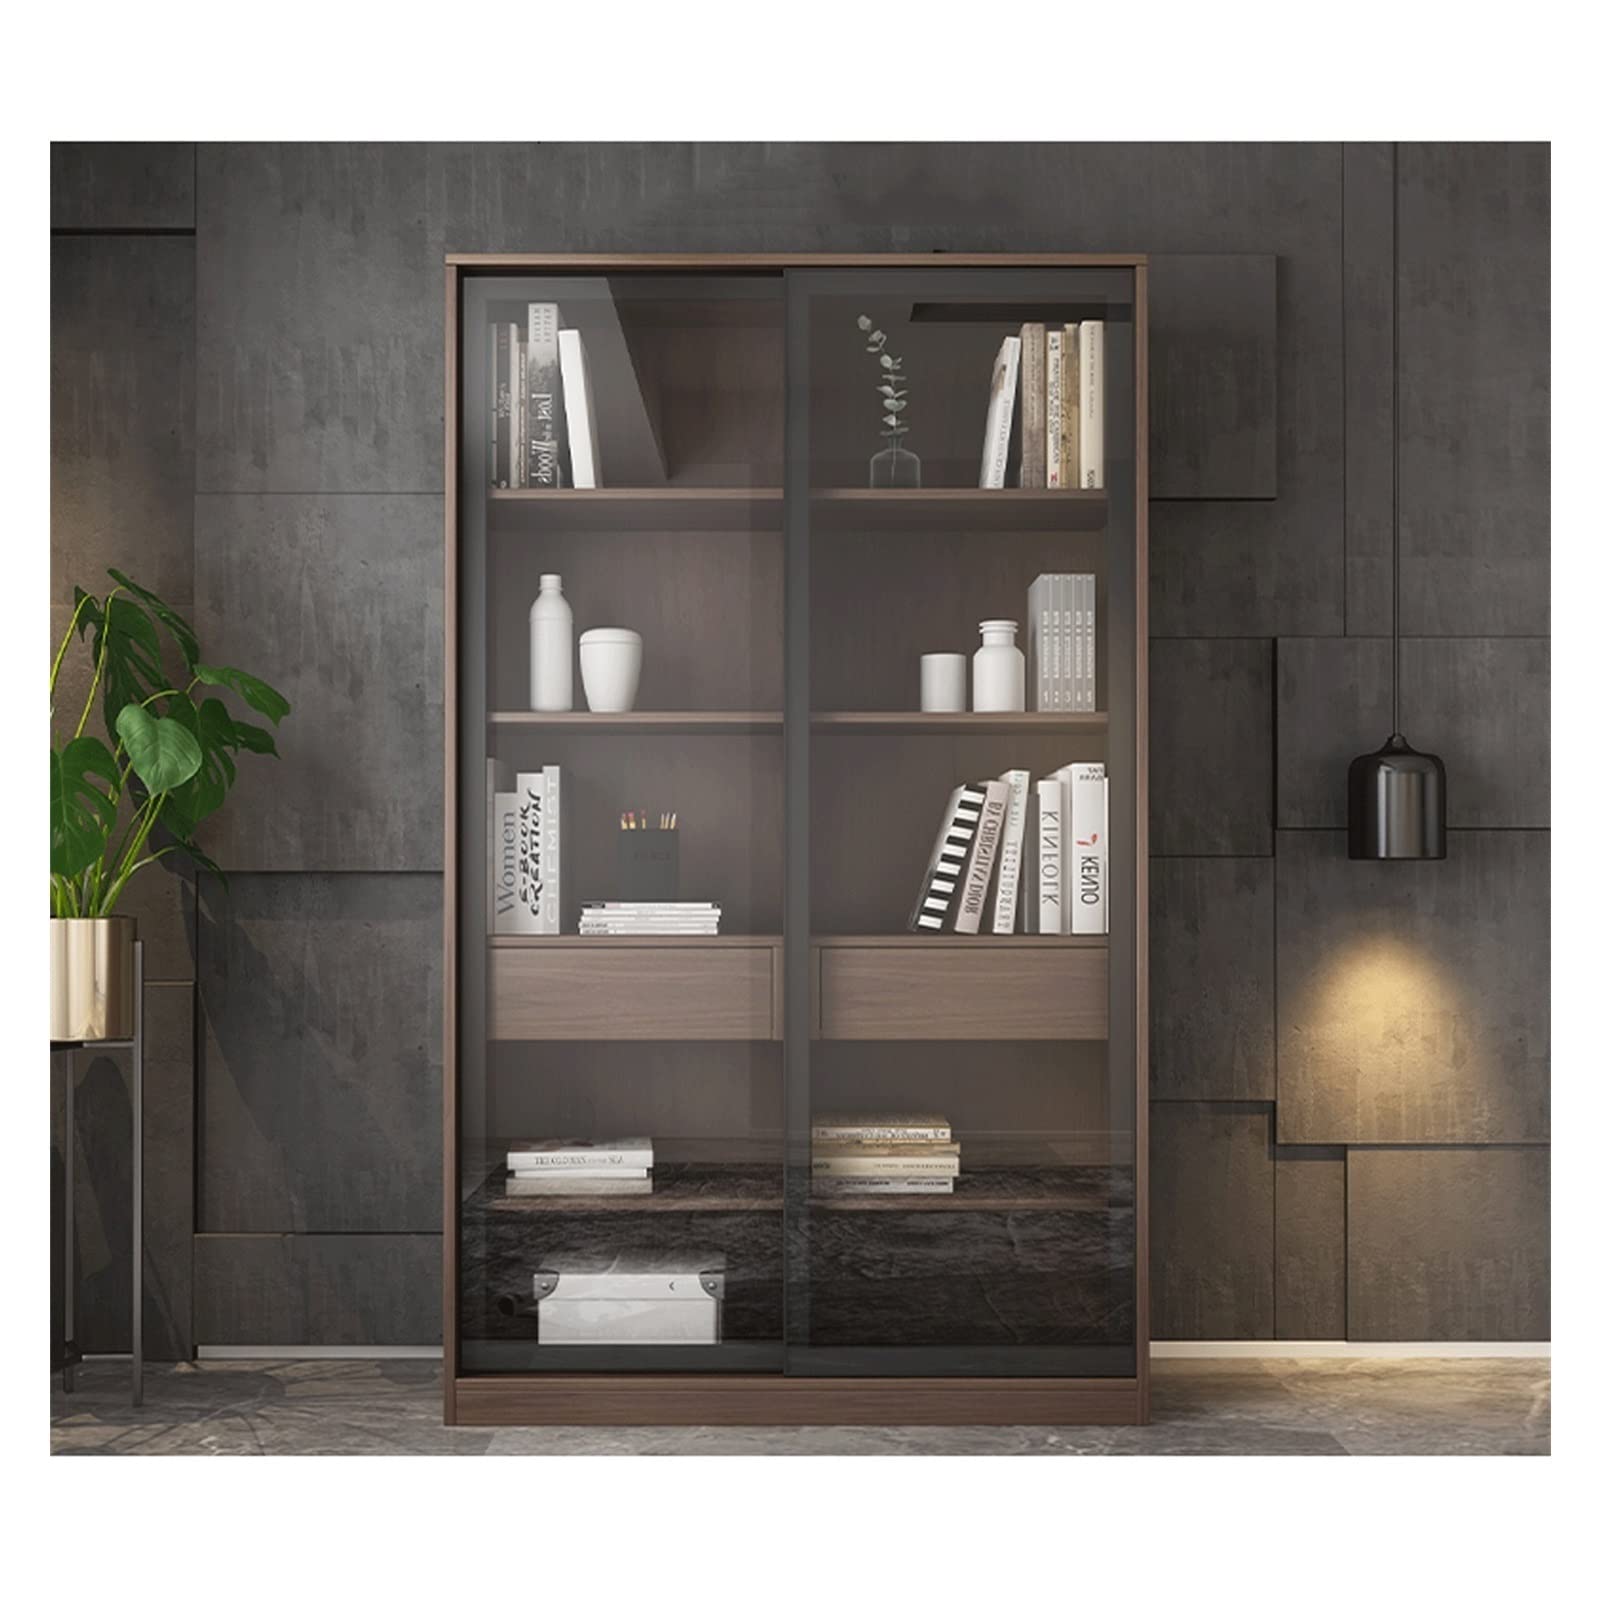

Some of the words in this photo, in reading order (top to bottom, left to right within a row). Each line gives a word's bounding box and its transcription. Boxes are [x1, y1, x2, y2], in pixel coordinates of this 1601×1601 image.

[497, 811, 516, 915] Women
[519, 801, 531, 904] E-BOOK
[527, 787, 543, 916] CREATION
